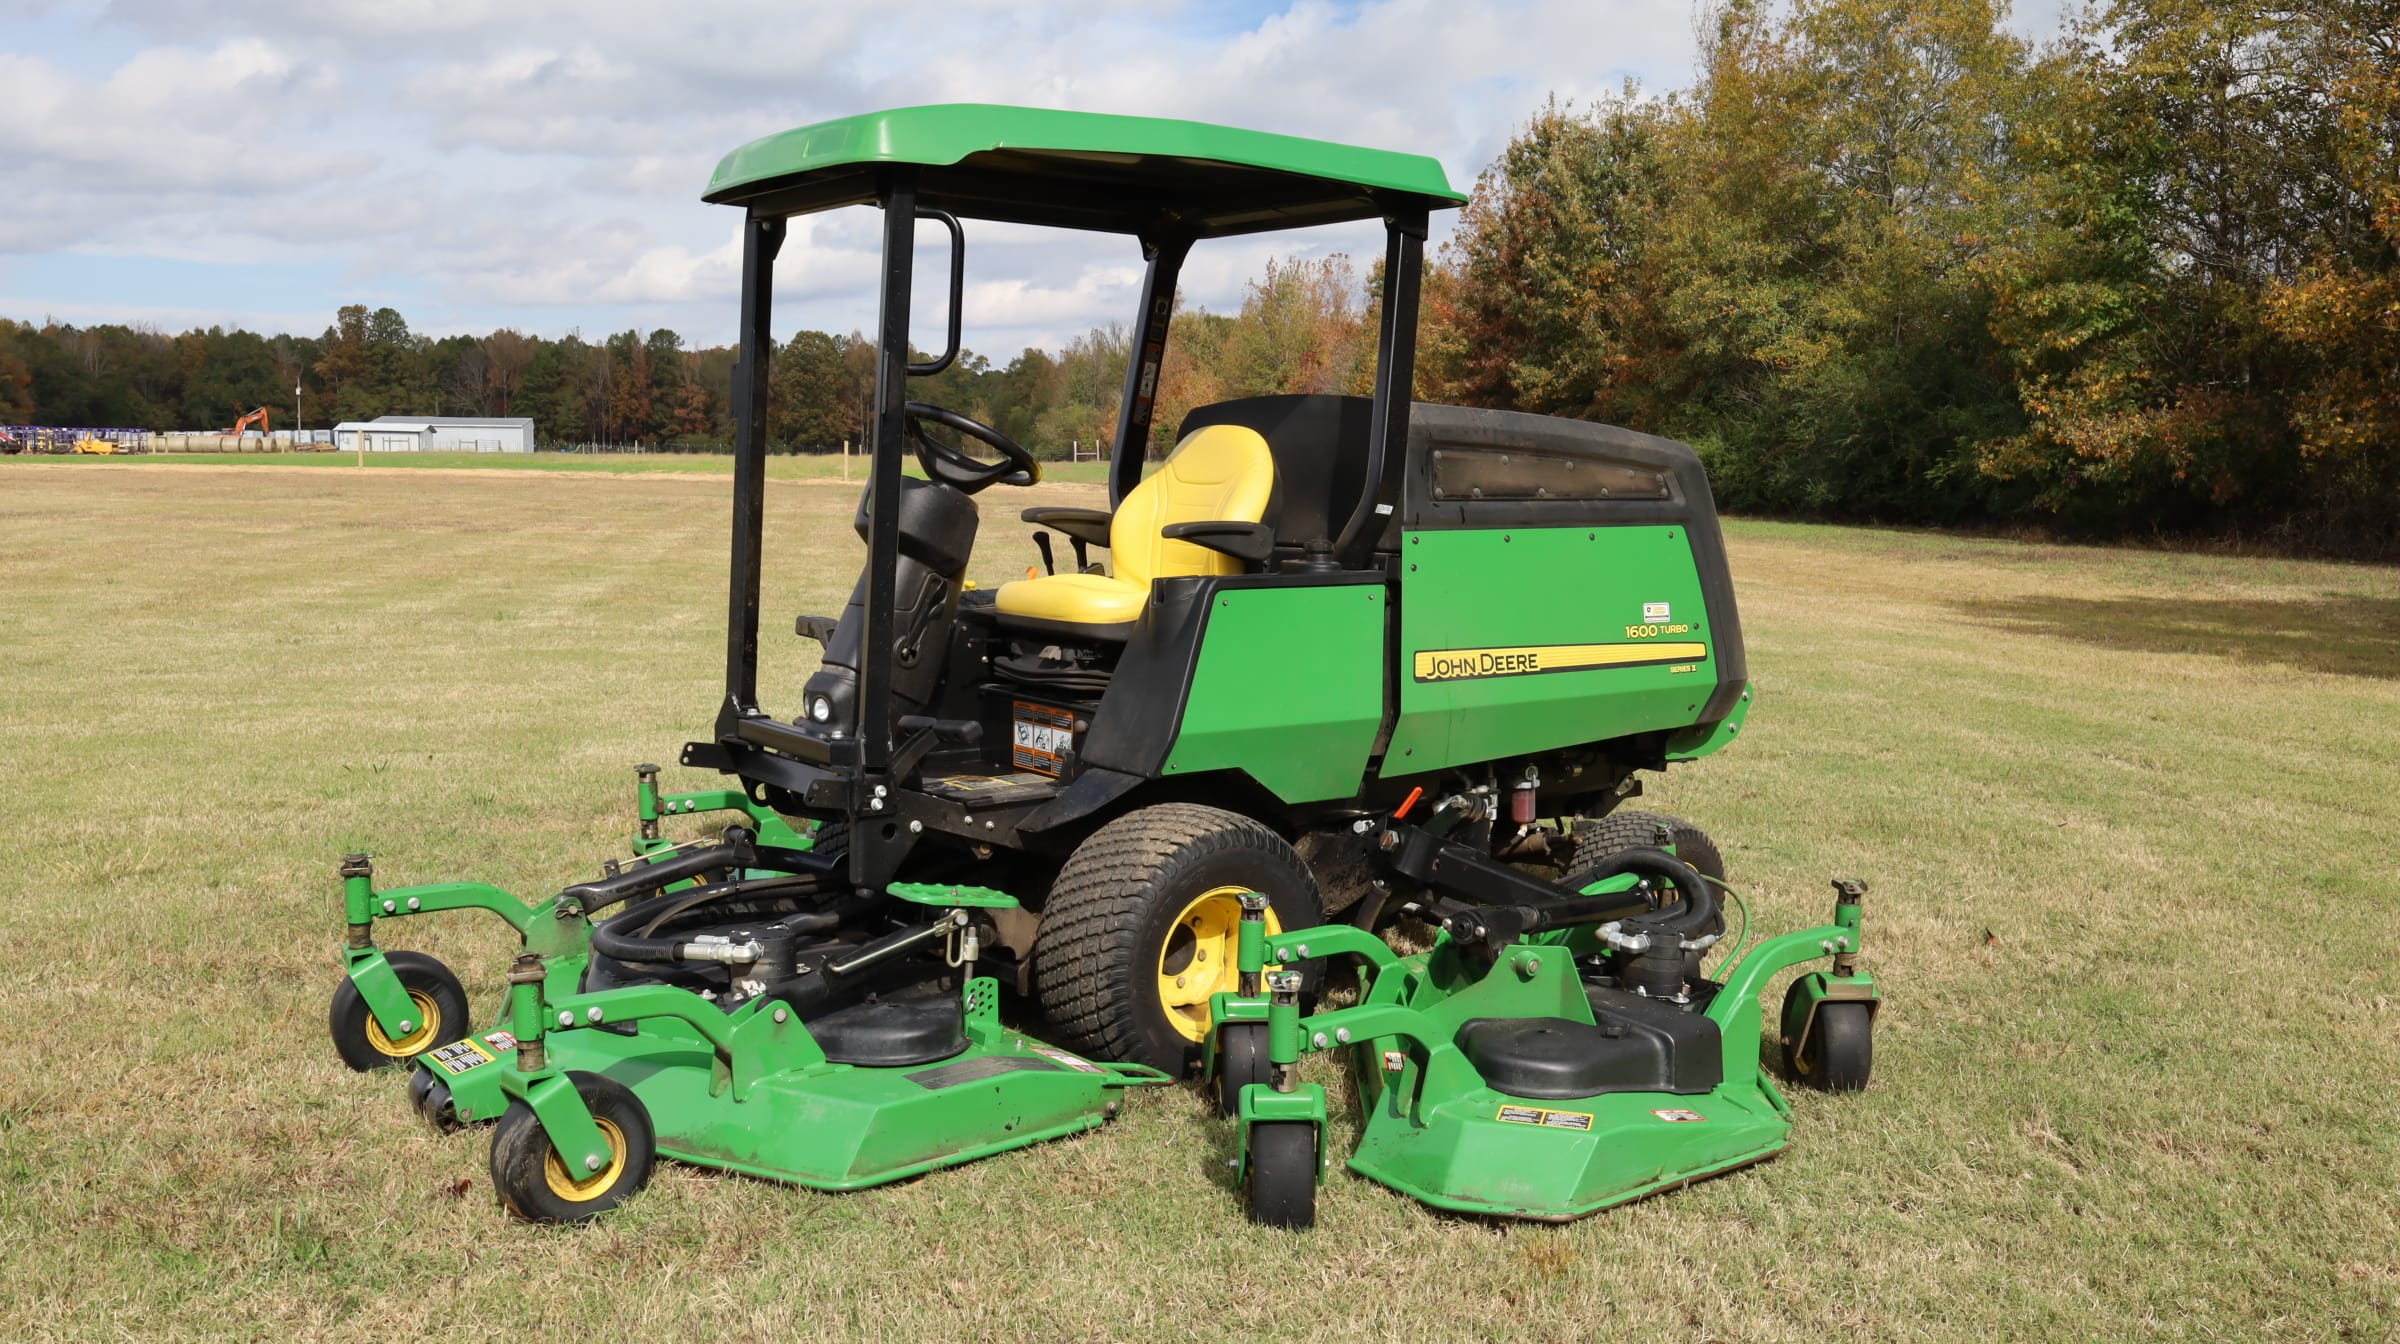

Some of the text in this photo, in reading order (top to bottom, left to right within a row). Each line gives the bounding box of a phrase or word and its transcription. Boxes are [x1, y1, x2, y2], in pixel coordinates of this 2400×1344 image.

[1625, 623, 1689, 639] 1600 TURBO
[1426, 653, 1539, 677] JOHN DEERE
